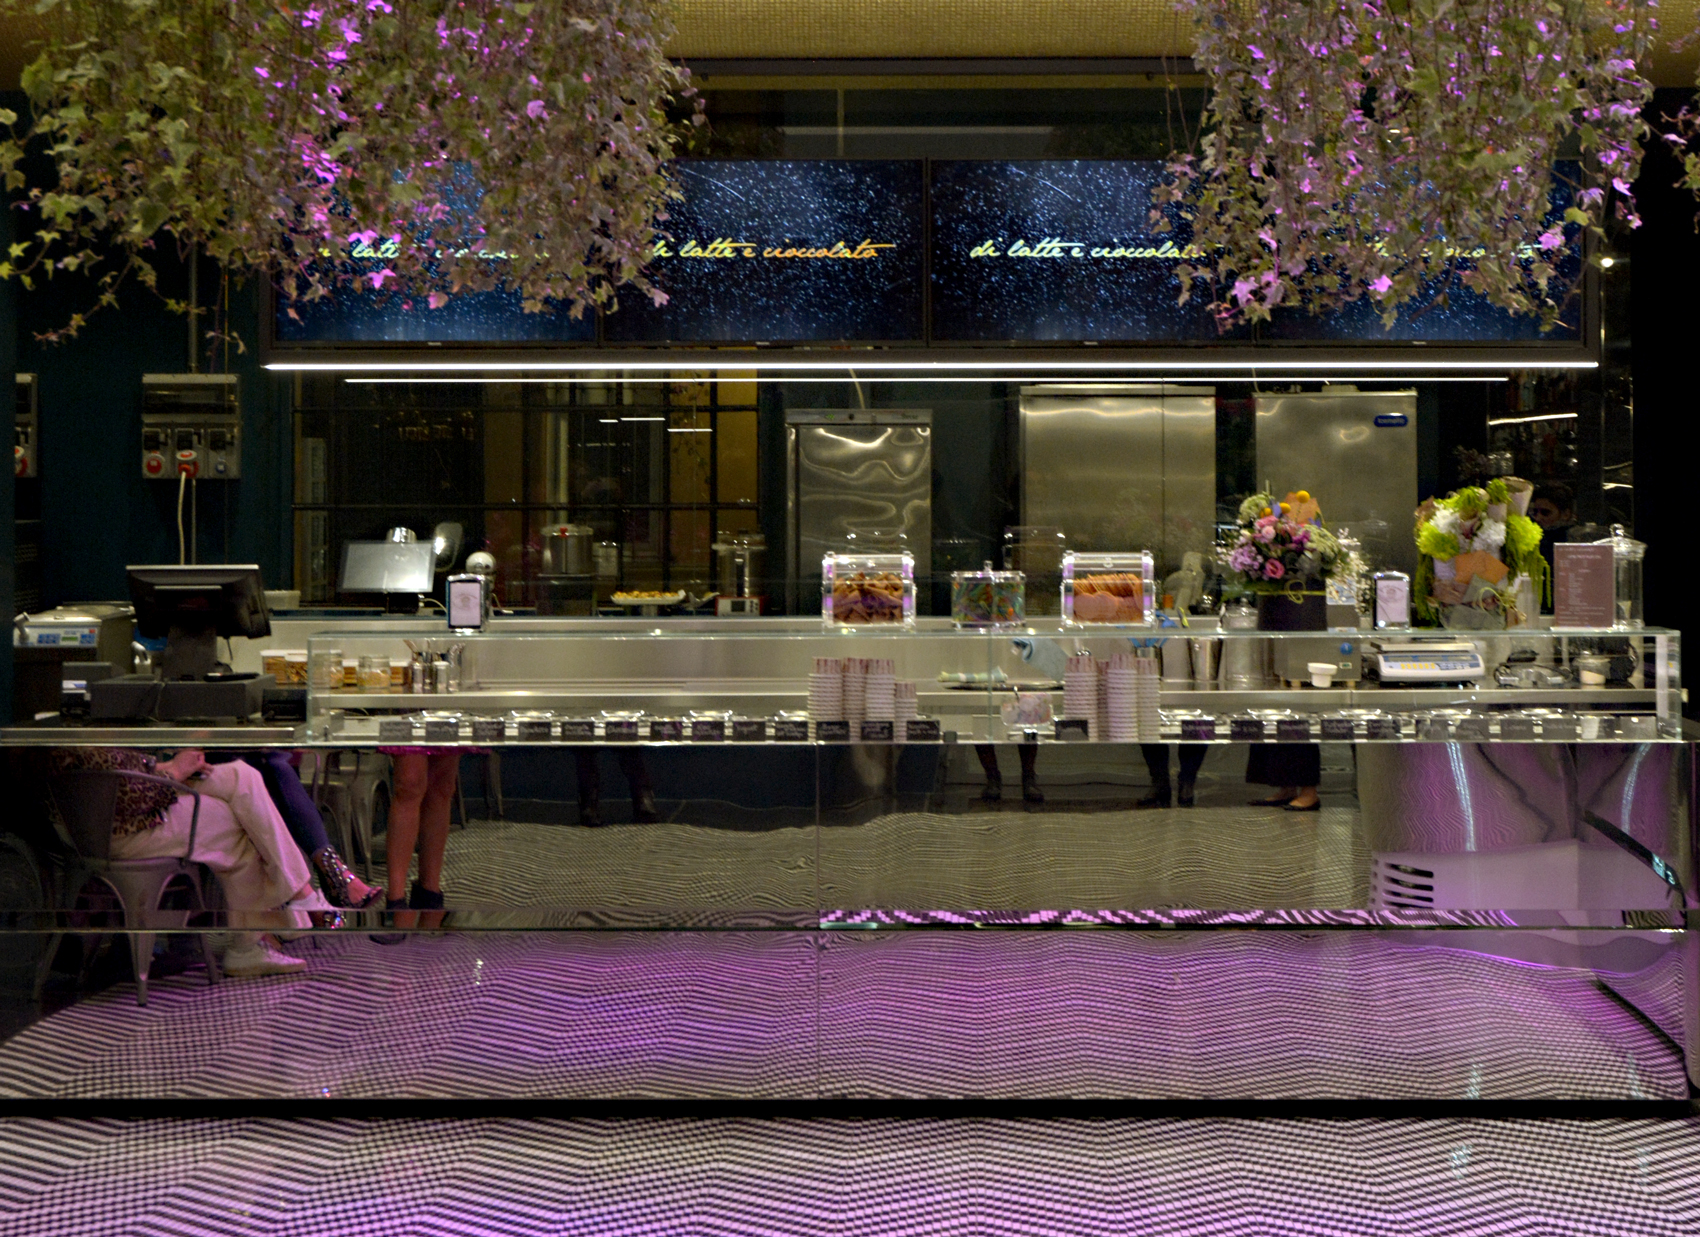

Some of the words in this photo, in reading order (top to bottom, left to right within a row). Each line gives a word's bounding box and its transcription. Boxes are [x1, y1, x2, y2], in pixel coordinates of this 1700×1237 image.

[352, 238, 400, 259] latt
[679, 237, 757, 258] latte
[743, 246, 757, 258] e
[762, 237, 896, 260] cioccolato
[969, 236, 1003, 258] di
[1007, 236, 1085, 258] latte
[1070, 246, 1085, 258] e
